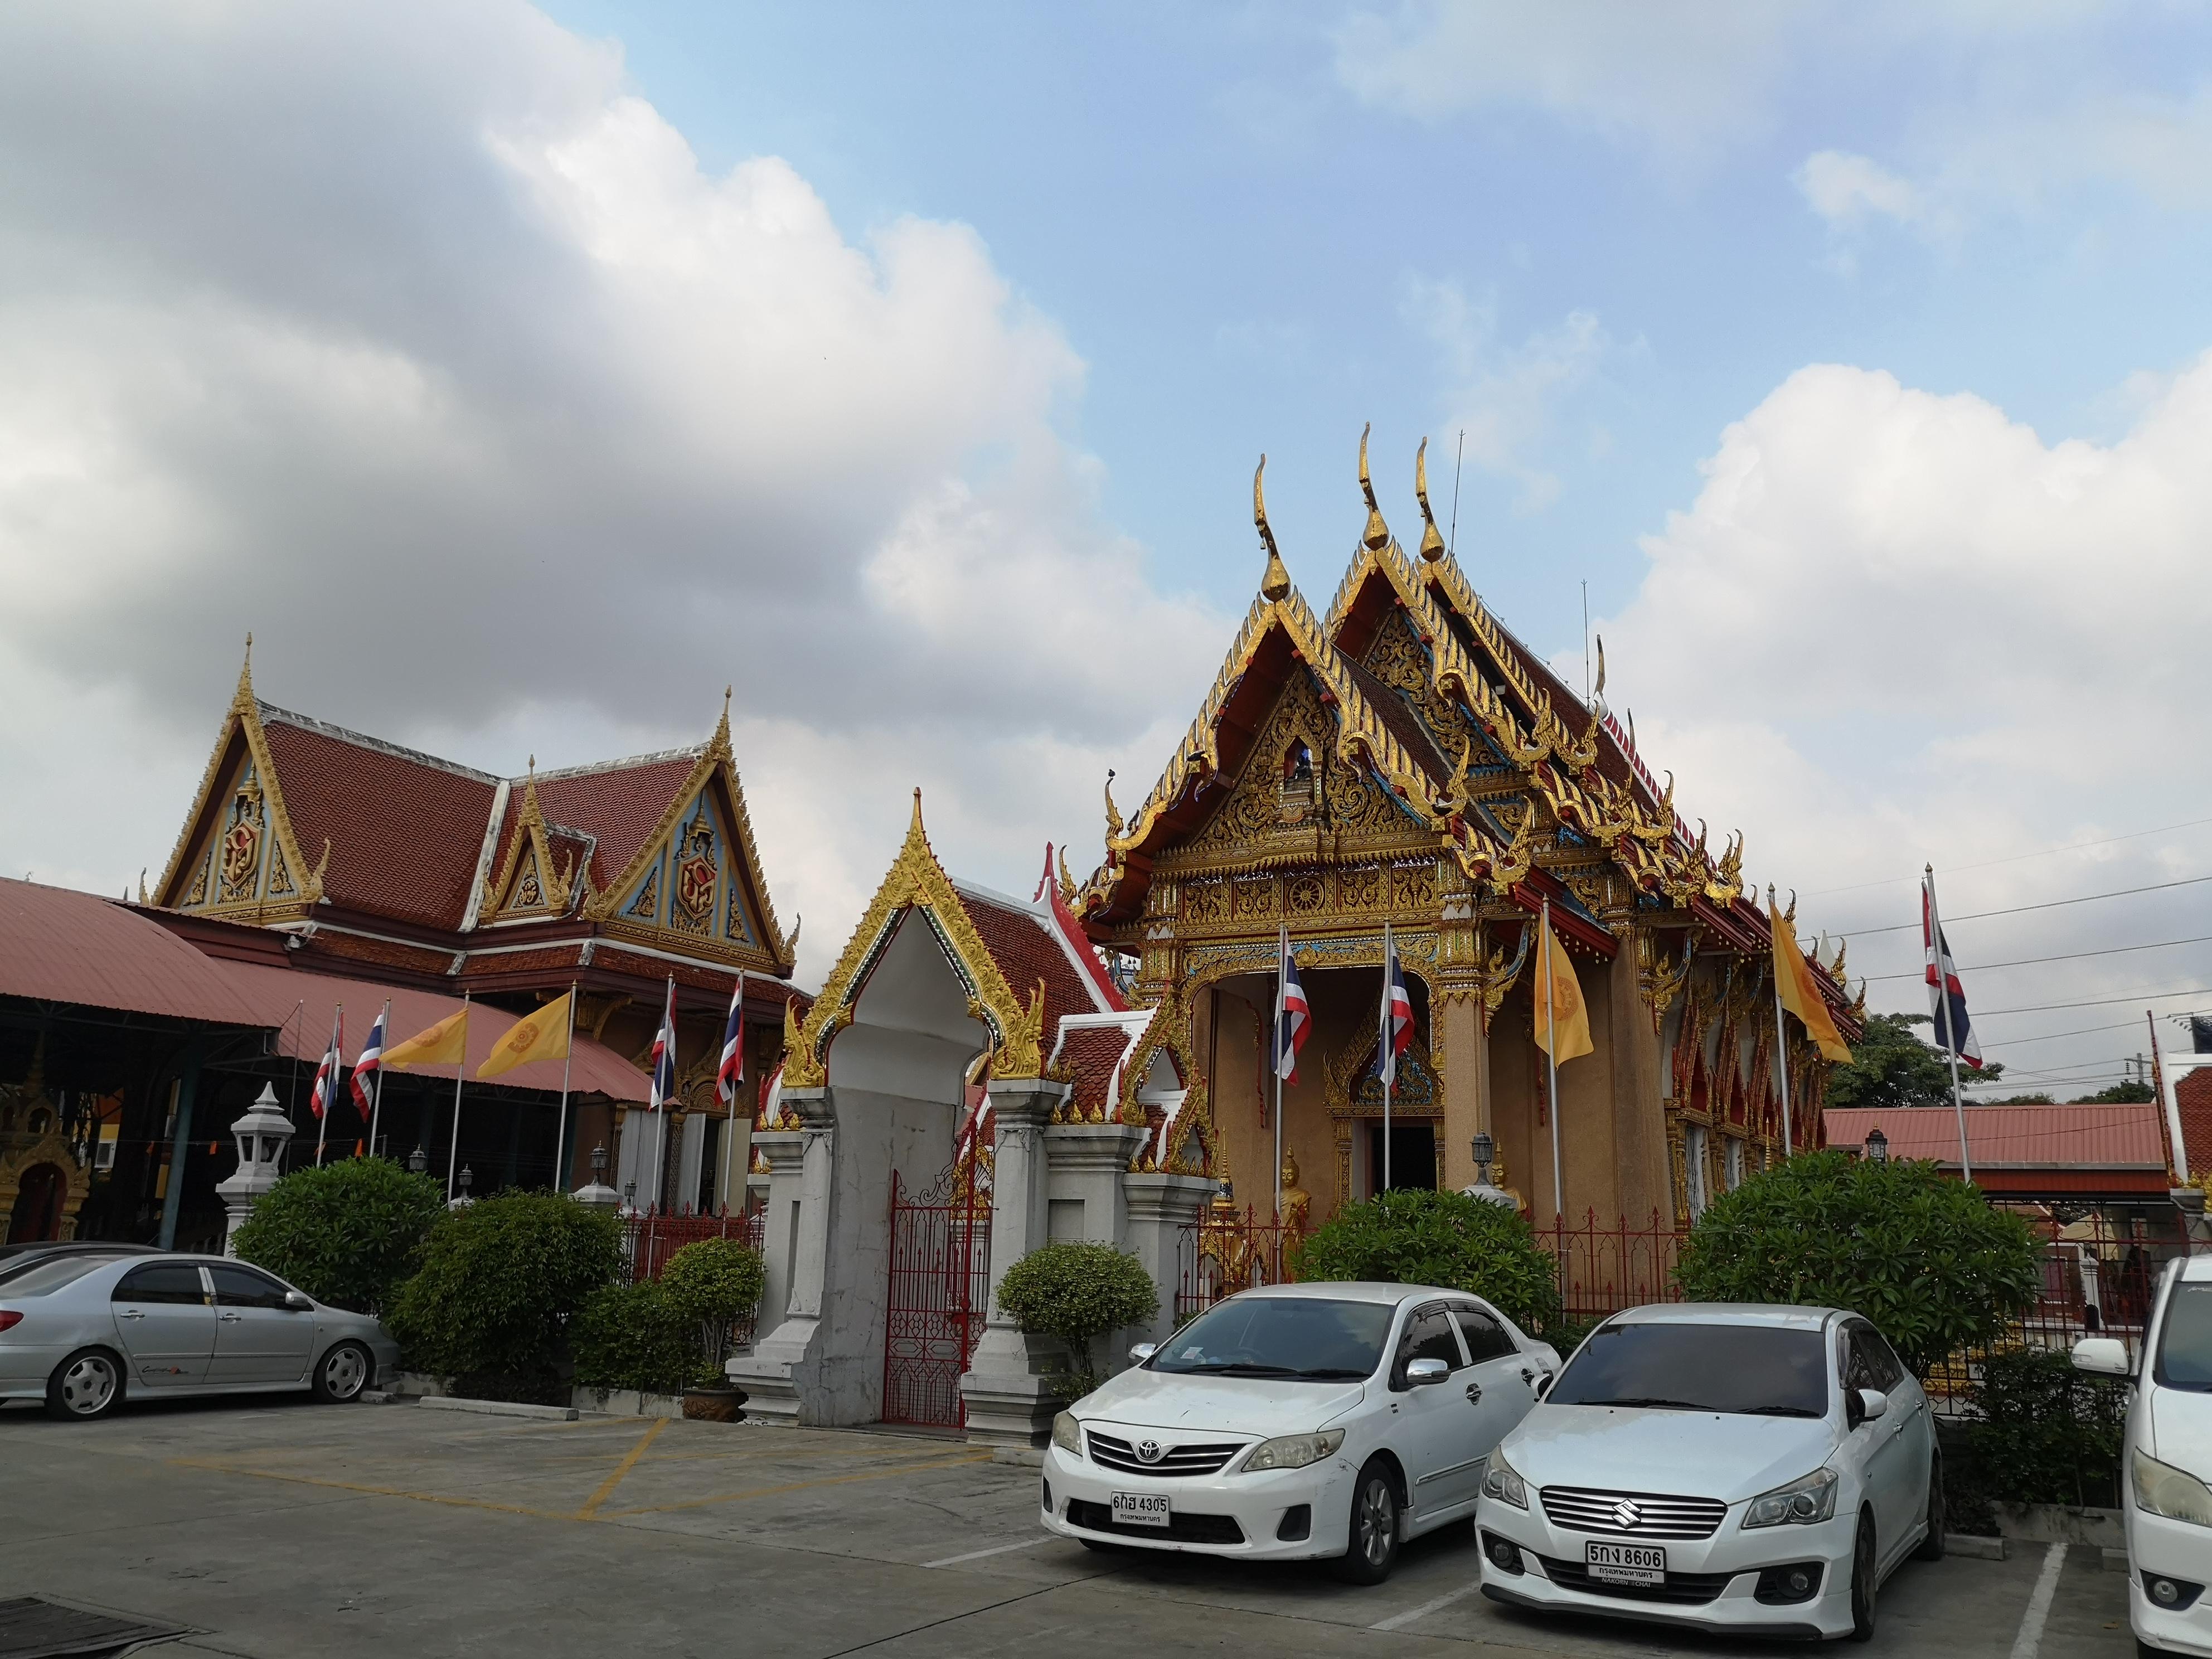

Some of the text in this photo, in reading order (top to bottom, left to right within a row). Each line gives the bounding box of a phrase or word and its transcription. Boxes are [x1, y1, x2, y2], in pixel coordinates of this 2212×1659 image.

[1139, 1498, 1167, 1512] 4305
[1120, 1514, 1160, 1522] กรุงเทพมหานคร
[1590, 1545, 1661, 1567] 5กง 8606
[1599, 1568, 1653, 1578] กรุงเทพมหานคร
